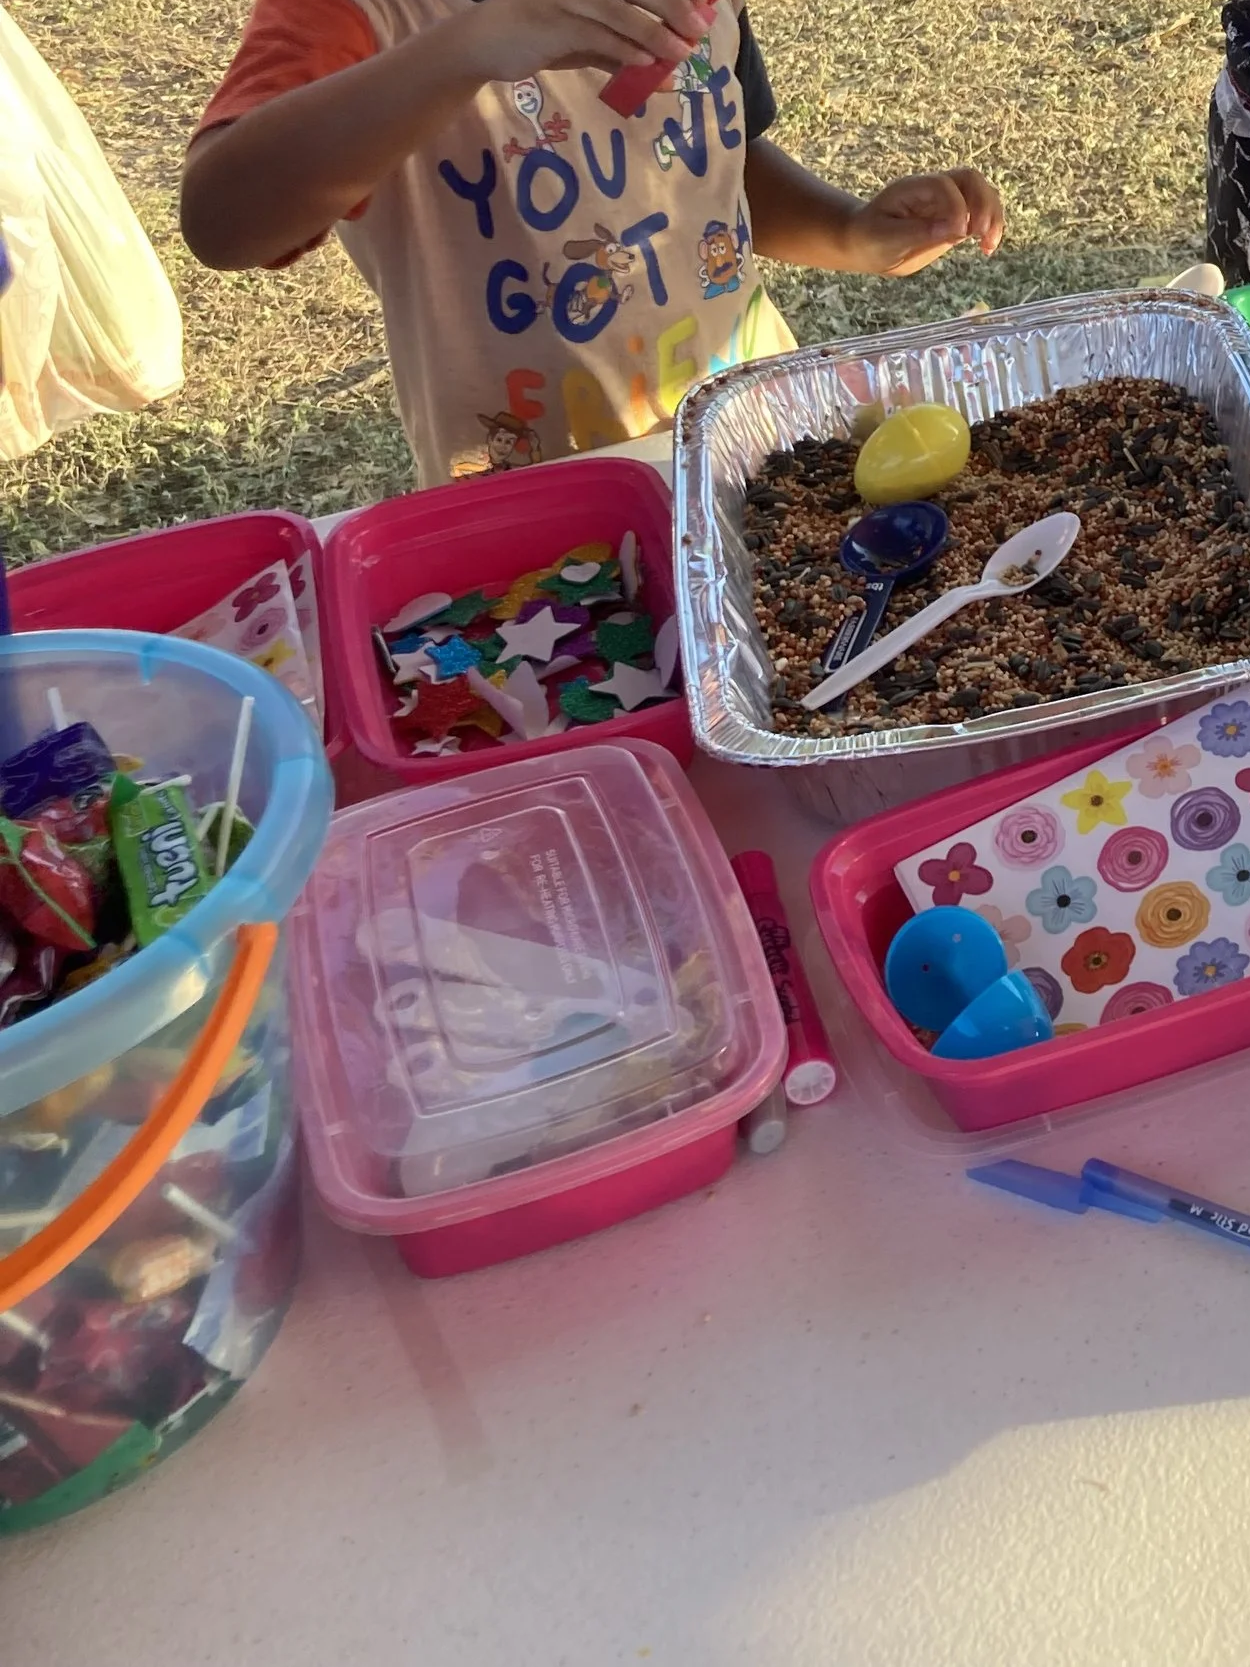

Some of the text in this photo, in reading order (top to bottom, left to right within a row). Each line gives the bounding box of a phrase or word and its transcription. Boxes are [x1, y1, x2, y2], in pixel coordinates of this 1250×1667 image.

[486, 211, 669, 344] GOT
[1189, 1203, 1204, 1217] M
[1210, 1211, 1237, 1231] Stic
